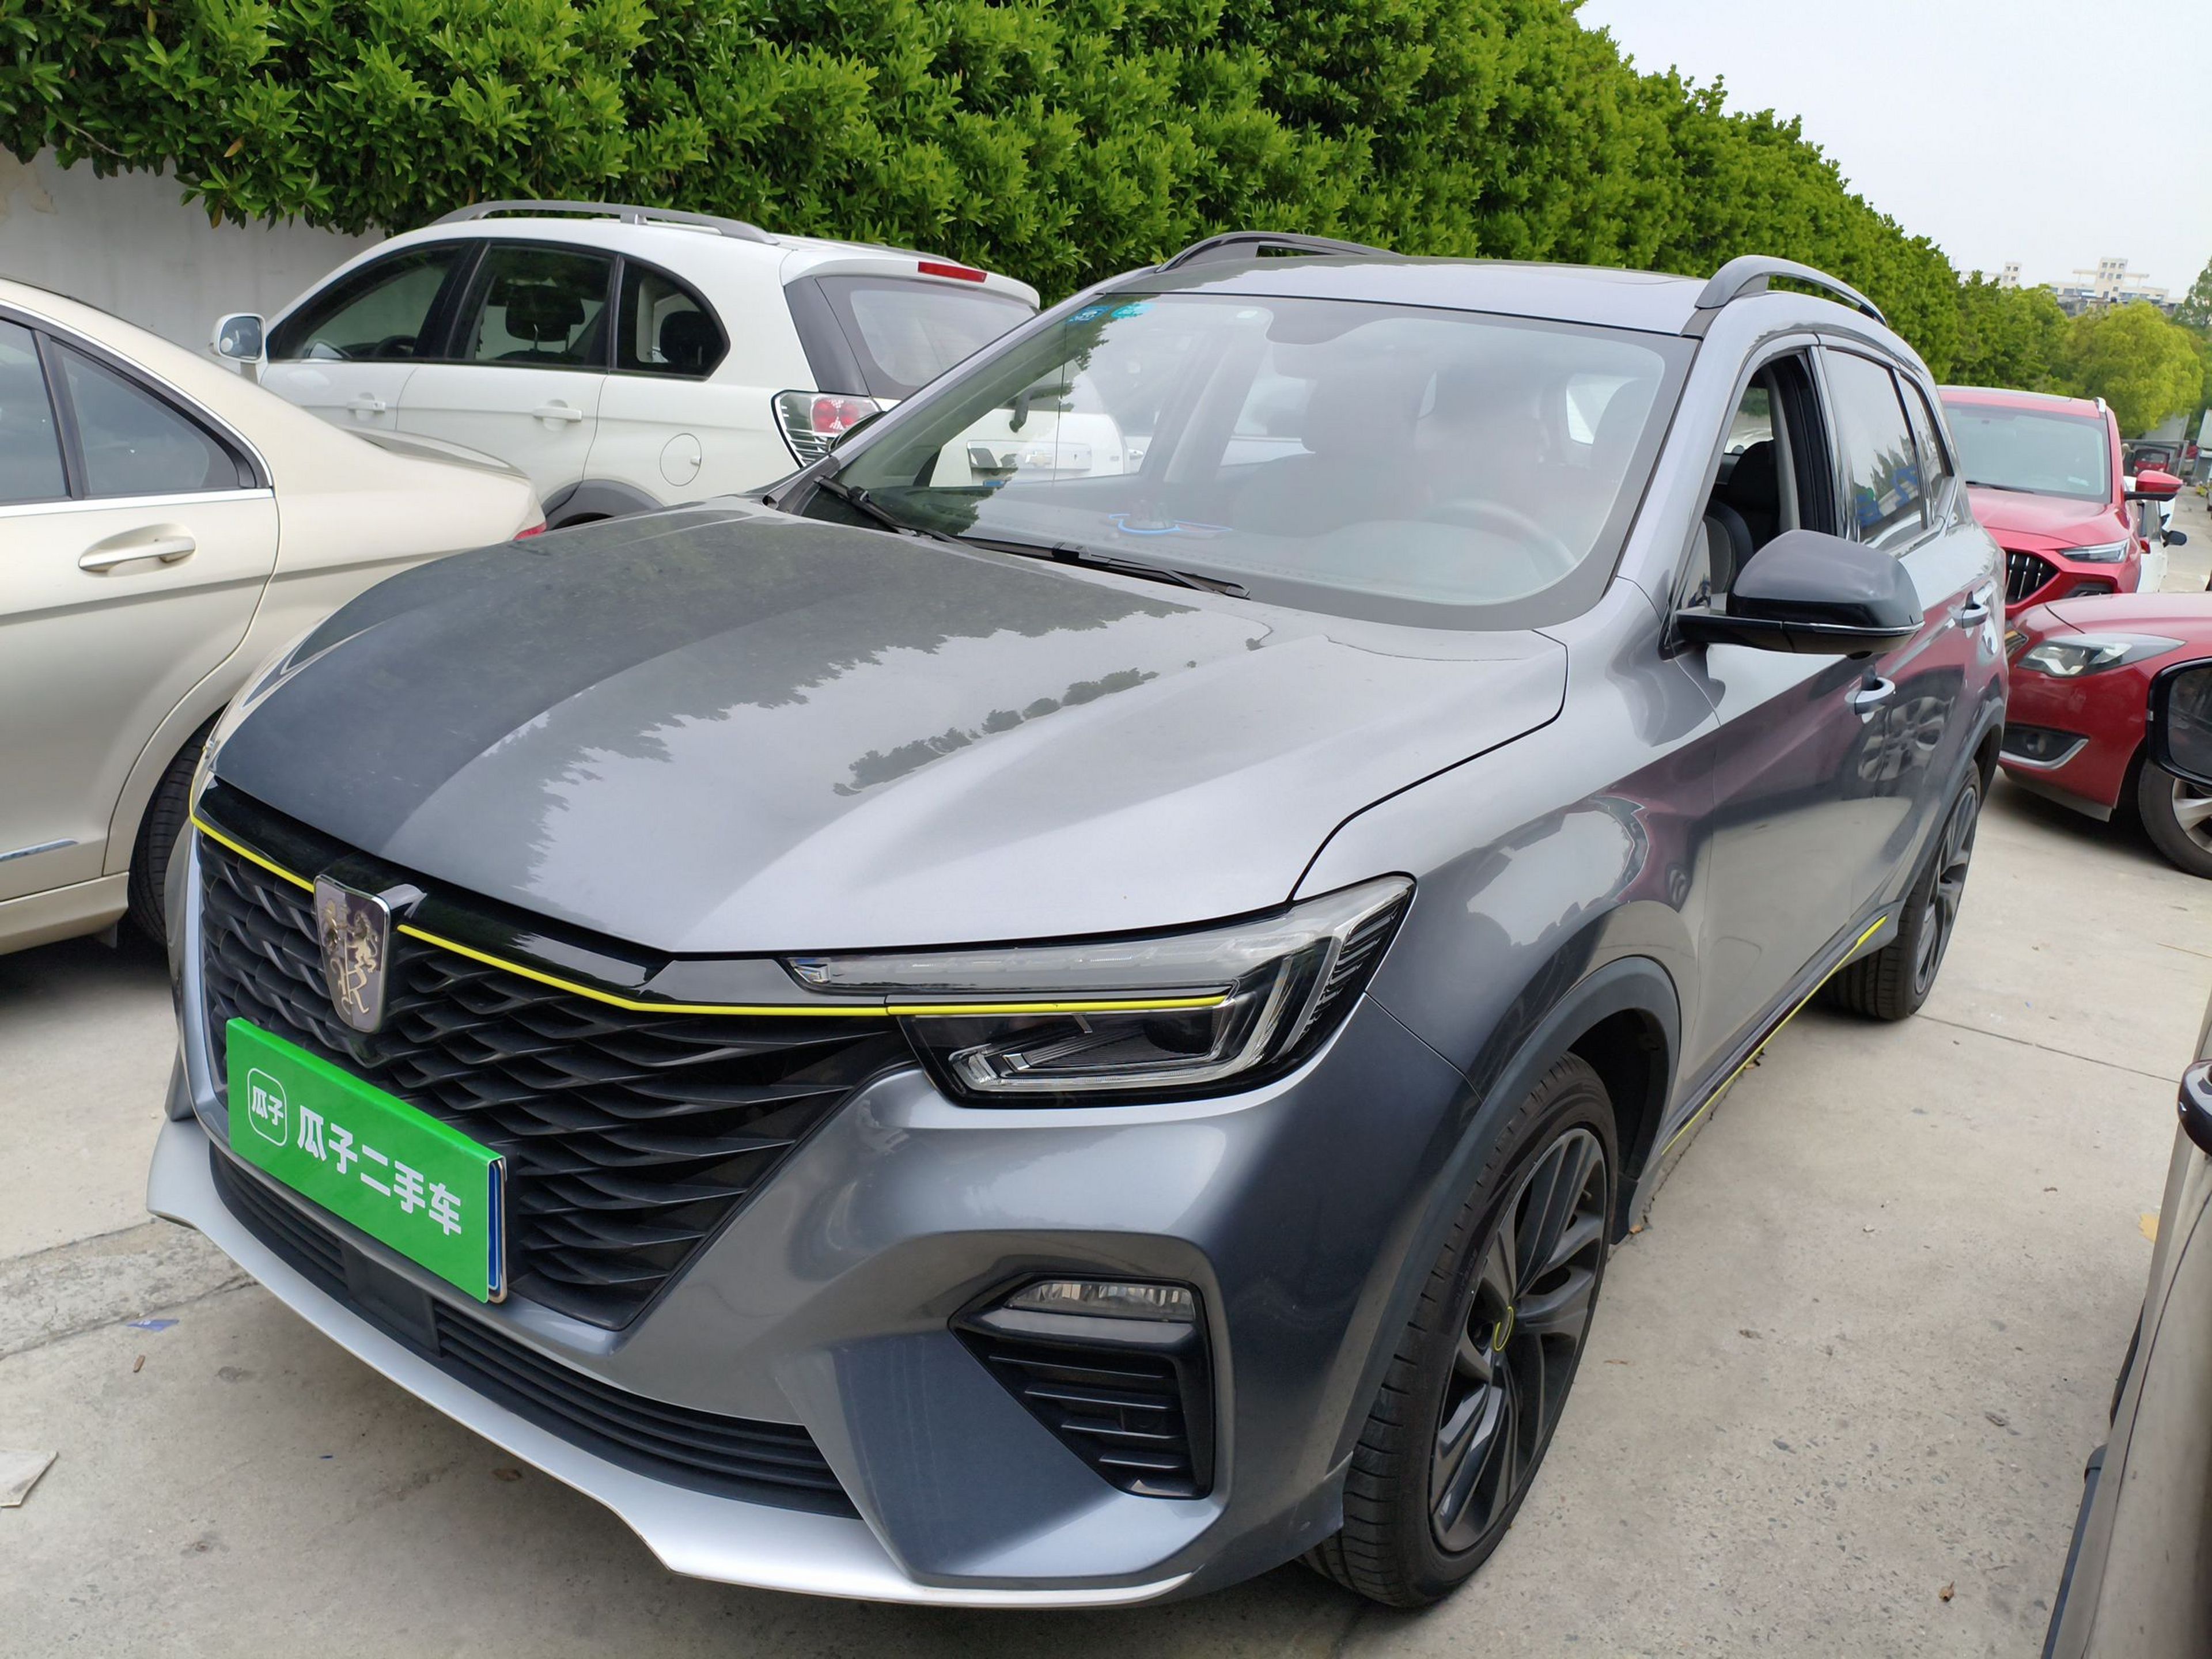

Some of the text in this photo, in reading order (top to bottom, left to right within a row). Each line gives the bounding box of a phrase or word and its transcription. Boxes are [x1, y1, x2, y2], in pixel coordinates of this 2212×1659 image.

[252, 1086, 284, 1126] 瓜子
[297, 1105, 461, 1236] 瓜子二手车
